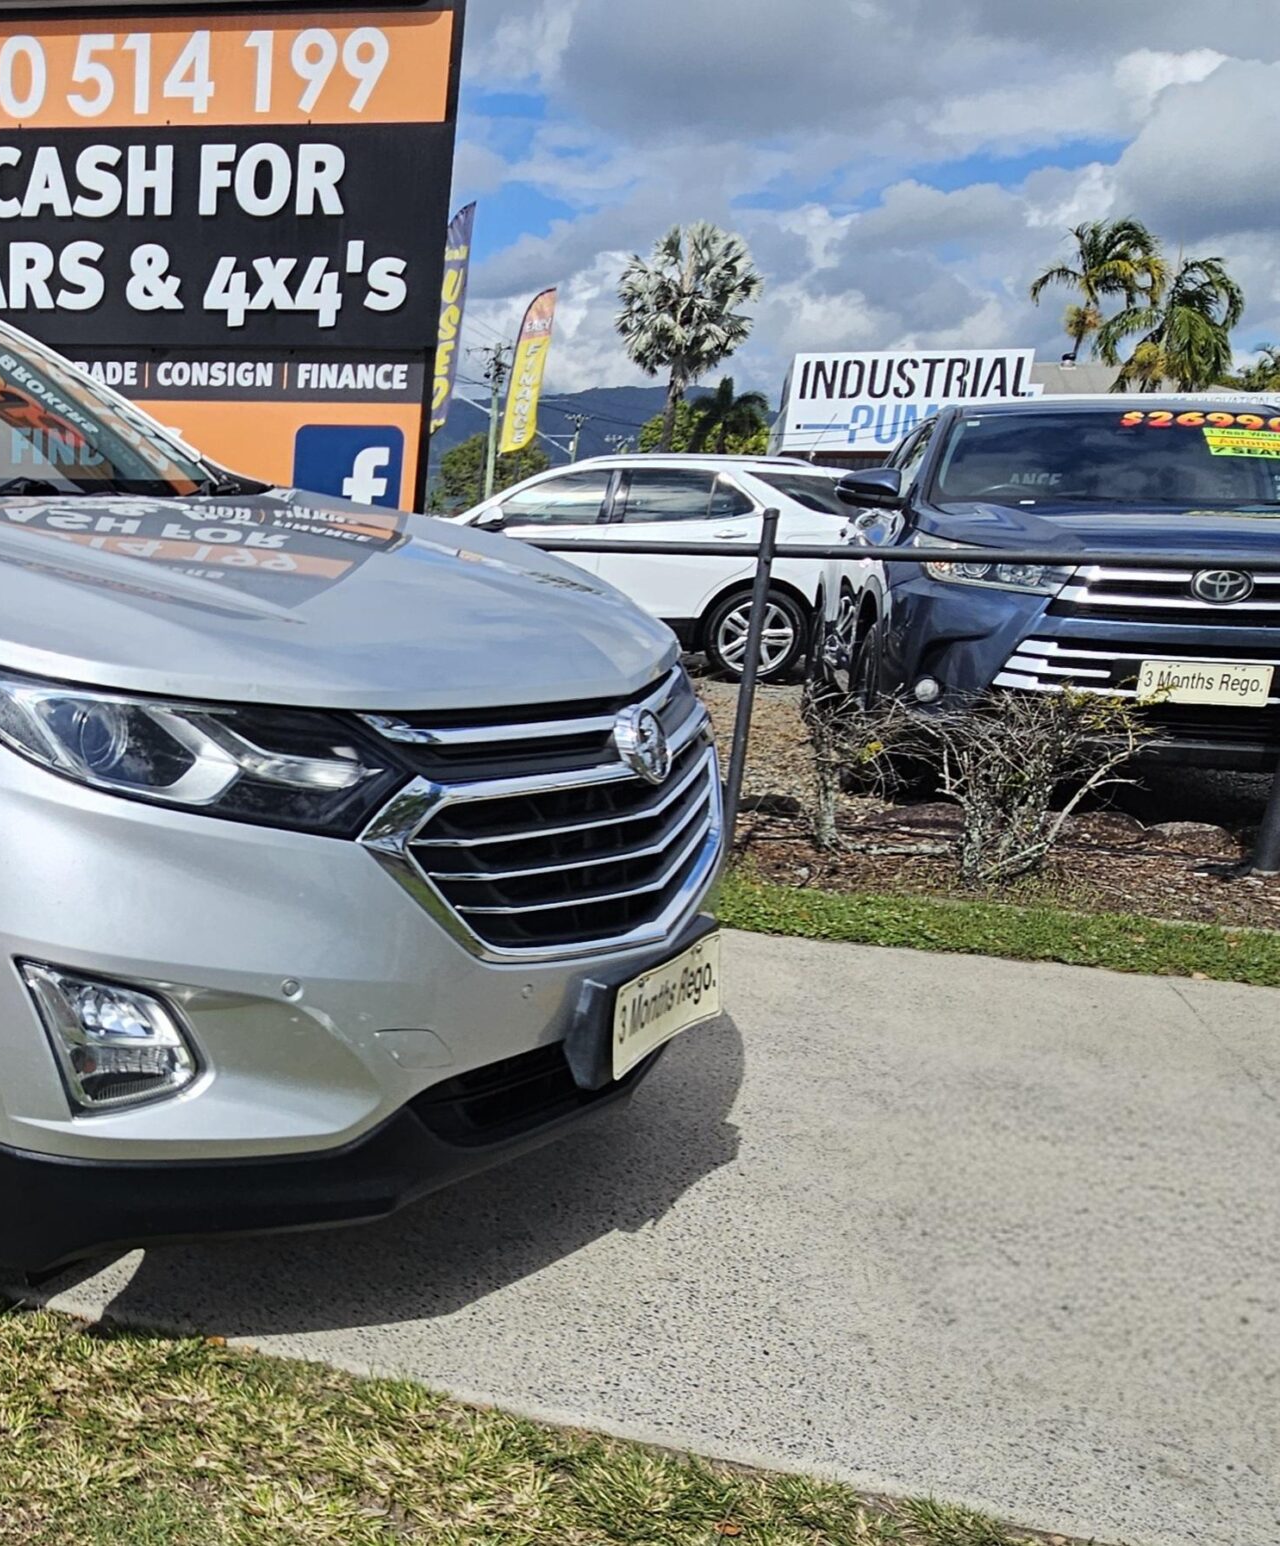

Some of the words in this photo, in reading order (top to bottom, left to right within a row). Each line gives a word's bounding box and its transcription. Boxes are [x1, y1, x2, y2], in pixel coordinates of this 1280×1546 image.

[67, 30, 214, 116] 514
[245, 27, 389, 113] 199
[198, 143, 346, 216] FOR
[126, 243, 184, 311] &
[431, 268, 463, 410] USED
[72, 361, 138, 386] RADE
[156, 361, 274, 387] CONSIGN
[297, 363, 409, 390] FINANCE
[513, 343, 541, 443] FINANCE
[799, 356, 1027, 400] INDUSTRIAL
[10, 427, 105, 466] FIND
[1143, 670, 1154, 687] 3
[1157, 671, 1215, 690] Months
[1218, 673, 1264, 697] Rego.
[618, 1005, 627, 1044] 3
[629, 980, 677, 1037] Months
[677, 962, 717, 1005] Rego.
